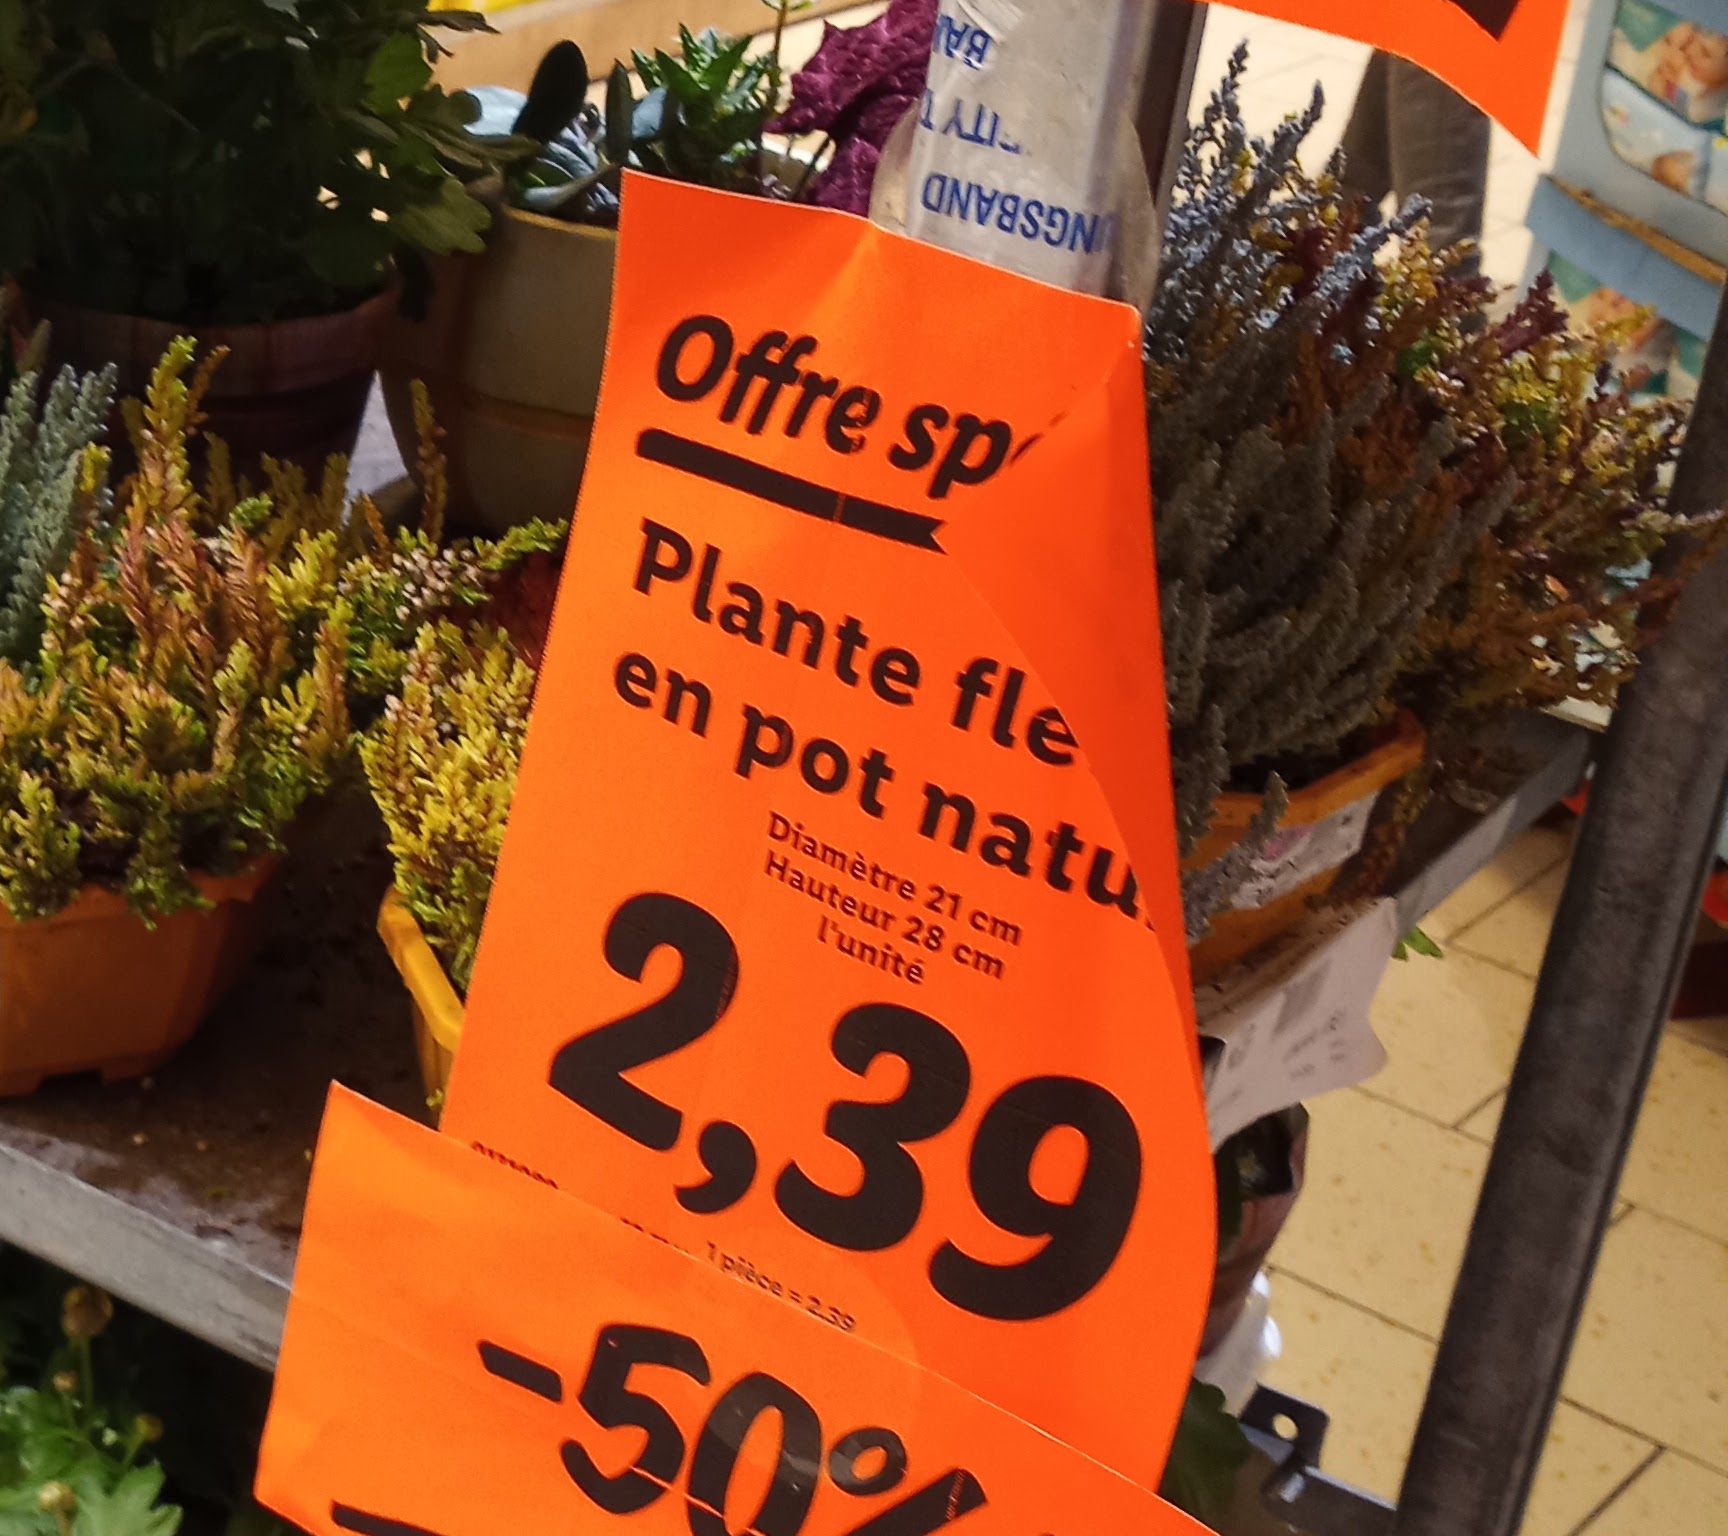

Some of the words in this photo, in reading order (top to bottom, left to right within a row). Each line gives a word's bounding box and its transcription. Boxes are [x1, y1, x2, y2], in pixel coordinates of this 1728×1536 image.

[654, 313, 881, 454] Offre
[888, 402, 1024, 499] sp
[633, 517, 922, 706] Plante
[950, 657, 1080, 767] fle
[614, 650, 713, 738] en
[734, 701, 896, 819] pot
[918, 780, 1156, 932] natu
[767, 809, 916, 902] Diamètre
[924, 884, 962, 921] 21
[969, 906, 1023, 947] cm
[764, 849, 894, 933] Hauteur
[902, 917, 945, 953] 28
[952, 942, 1005, 980] cm
[816, 915, 926, 985] l'unité
[547, 891, 1143, 1324] 2,39
